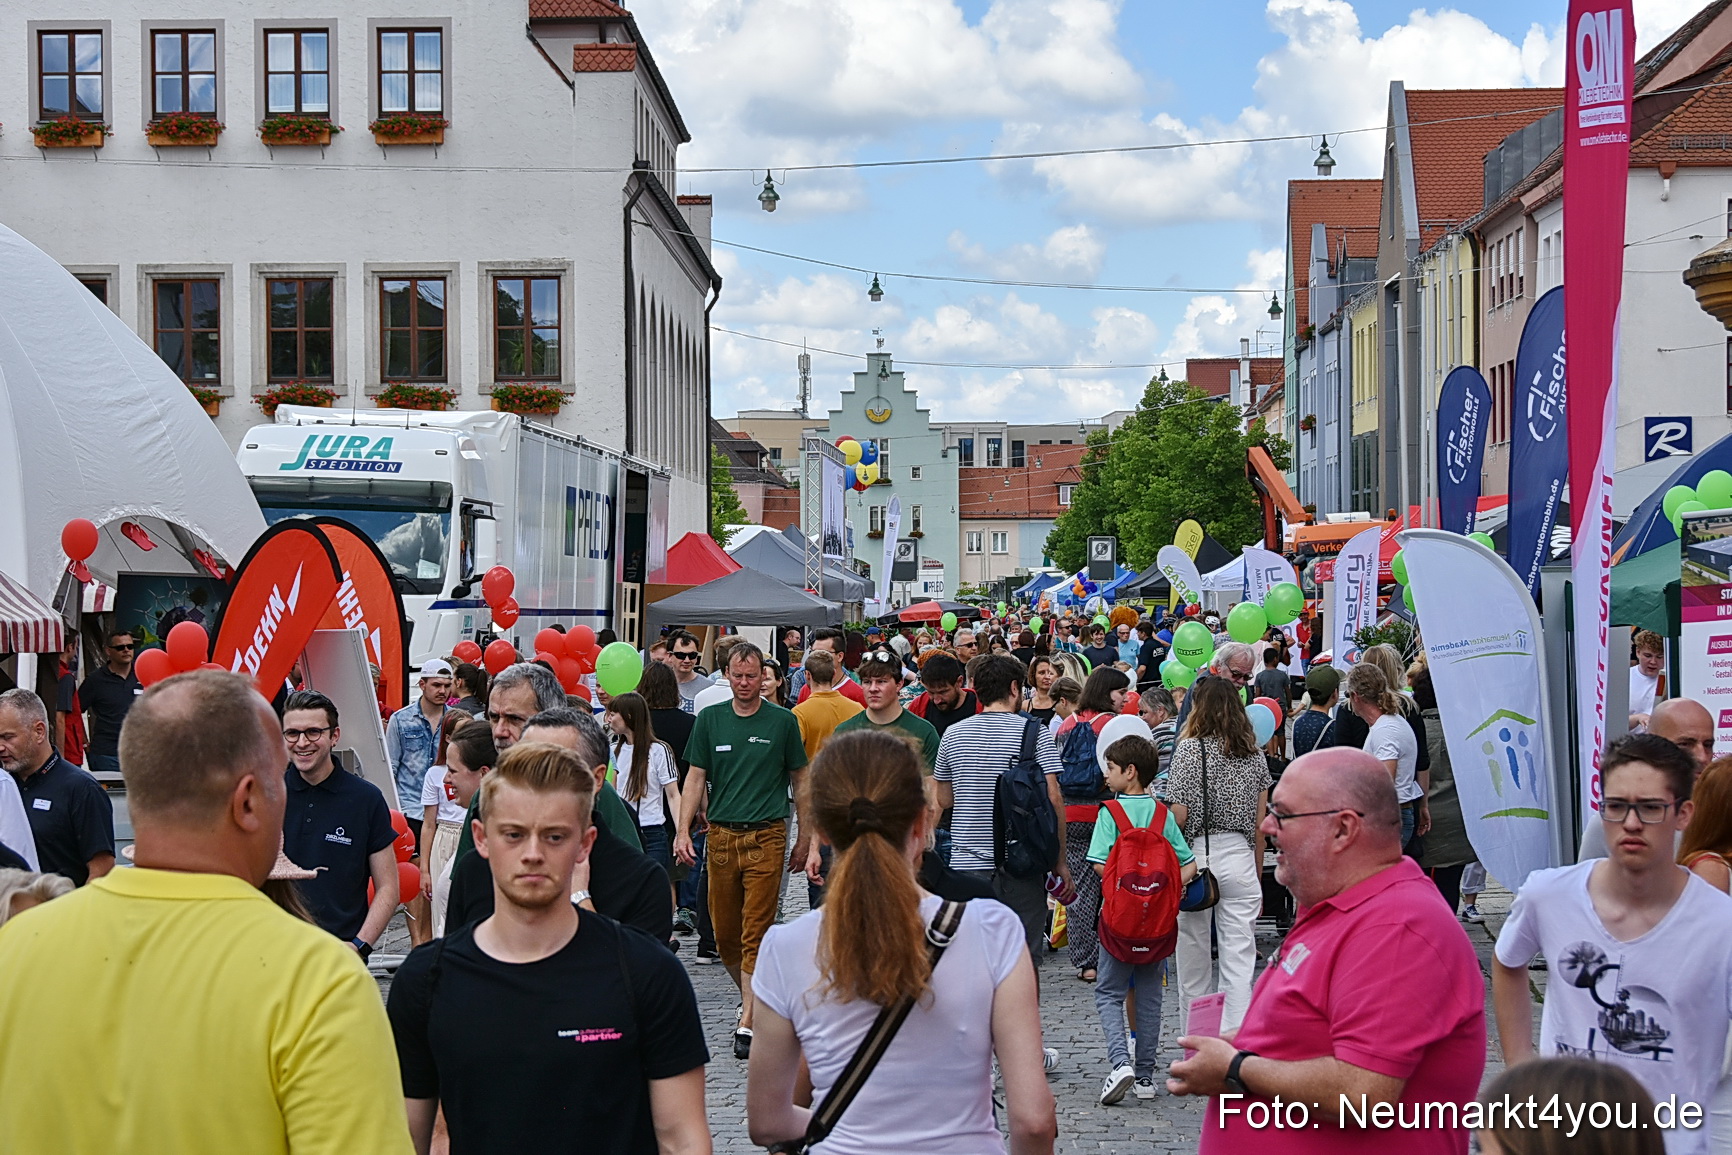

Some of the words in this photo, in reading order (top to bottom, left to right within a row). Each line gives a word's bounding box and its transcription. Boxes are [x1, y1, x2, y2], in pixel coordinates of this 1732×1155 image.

[1576, 8, 1623, 88] OM
[279, 434, 394, 470] JURA
[1454, 387, 1474, 469] Fischer
[1466, 397, 1480, 464] AUTOMOBILE
[308, 459, 398, 472] SPEDITION
[1312, 542, 1345, 553] Verke
[244, 583, 286, 678] DEHN
[1343, 554, 1365, 642] Petry
[581, 1032, 623, 1043] partner
